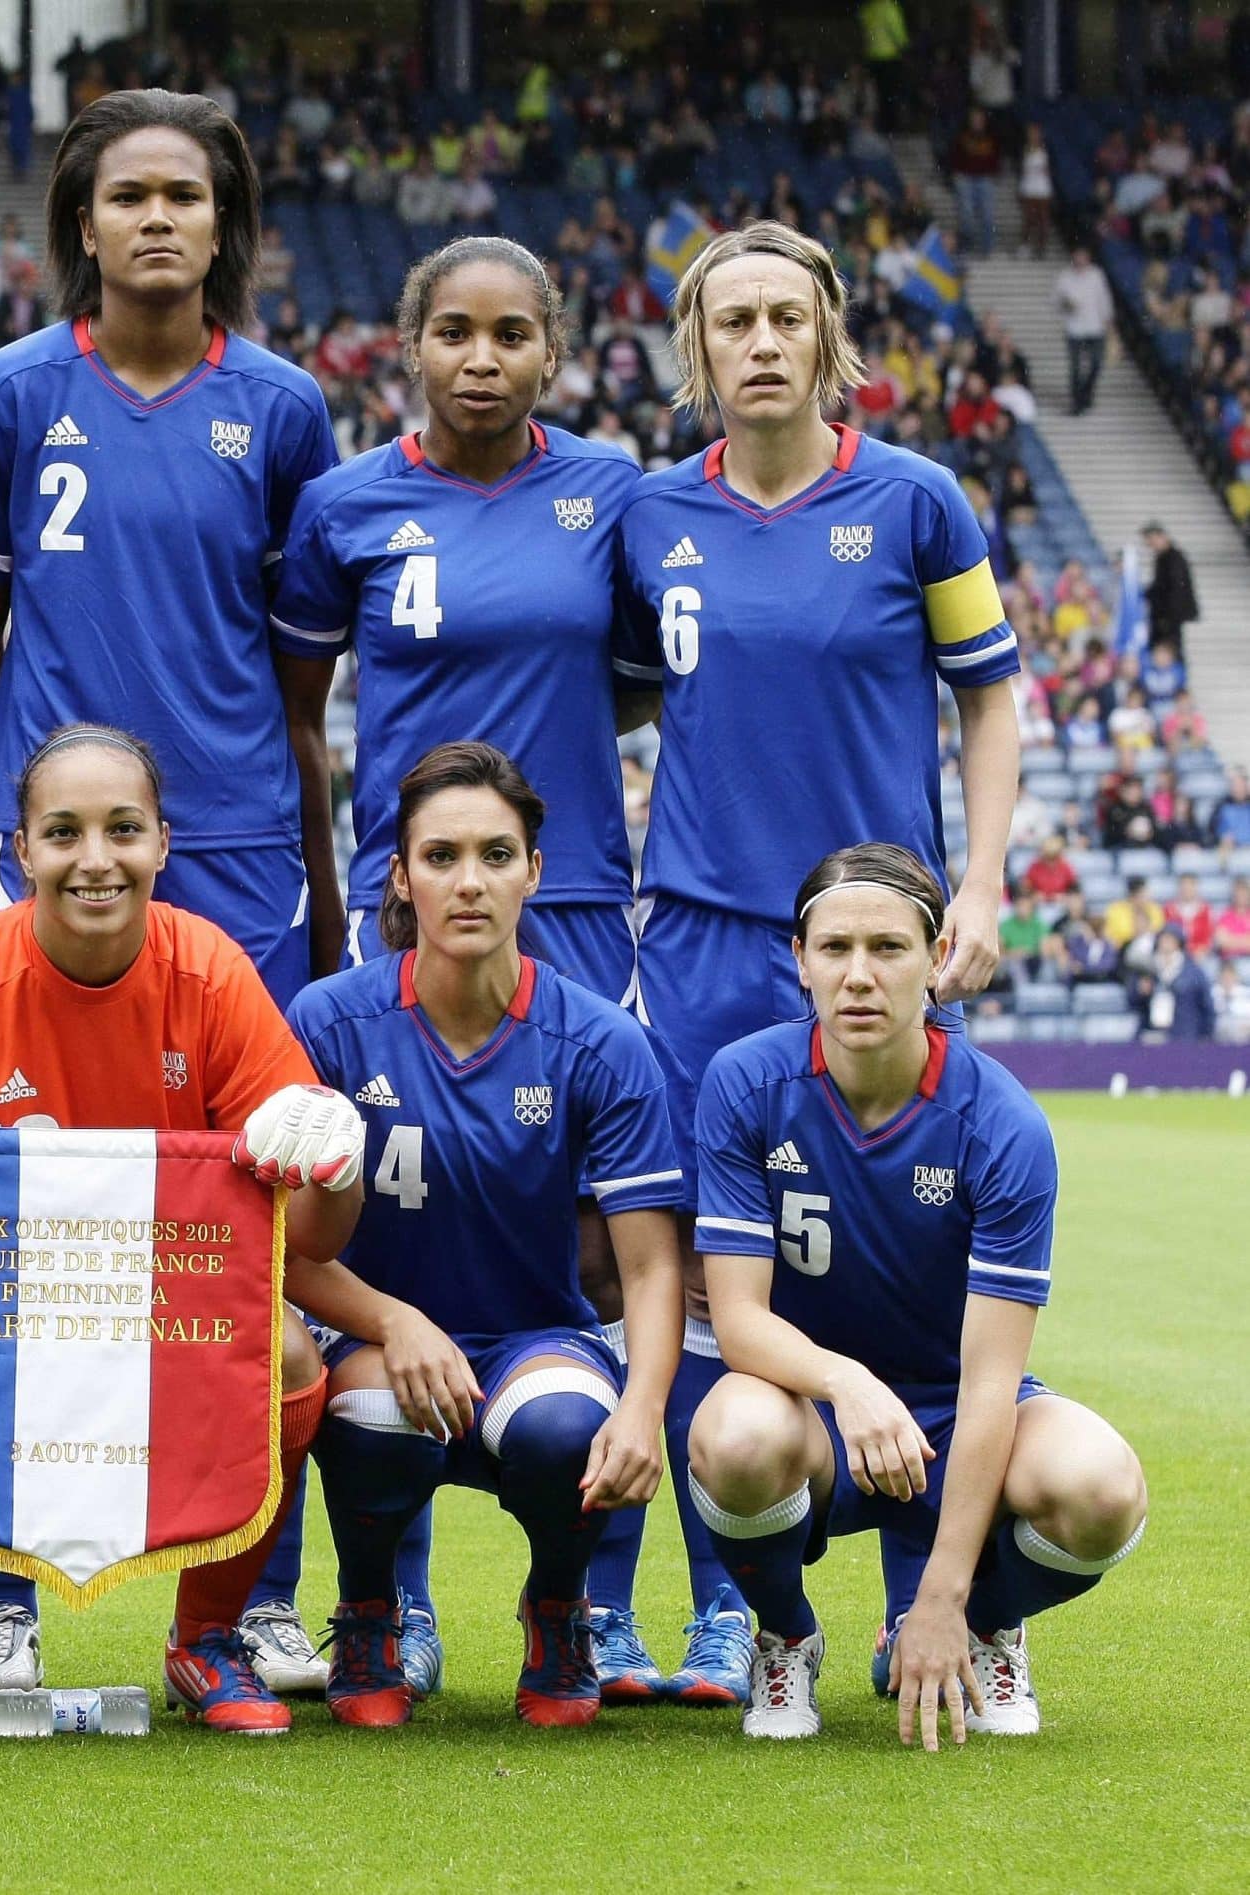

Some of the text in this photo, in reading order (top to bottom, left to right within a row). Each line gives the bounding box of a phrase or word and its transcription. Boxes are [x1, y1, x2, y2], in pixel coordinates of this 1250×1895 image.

[43, 433, 89, 446] adidas
[211, 420, 252, 442] FRANCE
[39, 462, 88, 551] 2
[553, 496, 594, 514] FRANCE
[386, 535, 435, 551] adidas
[830, 525, 873, 543] FRANCE
[661, 554, 703, 569] adidas
[391, 555, 443, 639] 4
[661, 585, 702, 675] 6
[355, 1091, 400, 1107] adidas
[514, 1086, 553, 1104] FRANCE
[361, 1121, 428, 1209] 4
[914, 1165, 956, 1185] FRANCE
[15, 1218, 179, 1243] OLYMPIQUES
[185, 1224, 232, 1243] 2012
[780, 1190, 831, 1277] 5
[62, 1251, 103, 1272] DE
[110, 1252, 225, 1274] FRANCE
[1, 1282, 169, 1305] FEMININE A
[54, 1315, 101, 1341] DE
[111, 1317, 235, 1344] FINALE
[11, 1441, 150, 1465] 3 AOUT 2012
